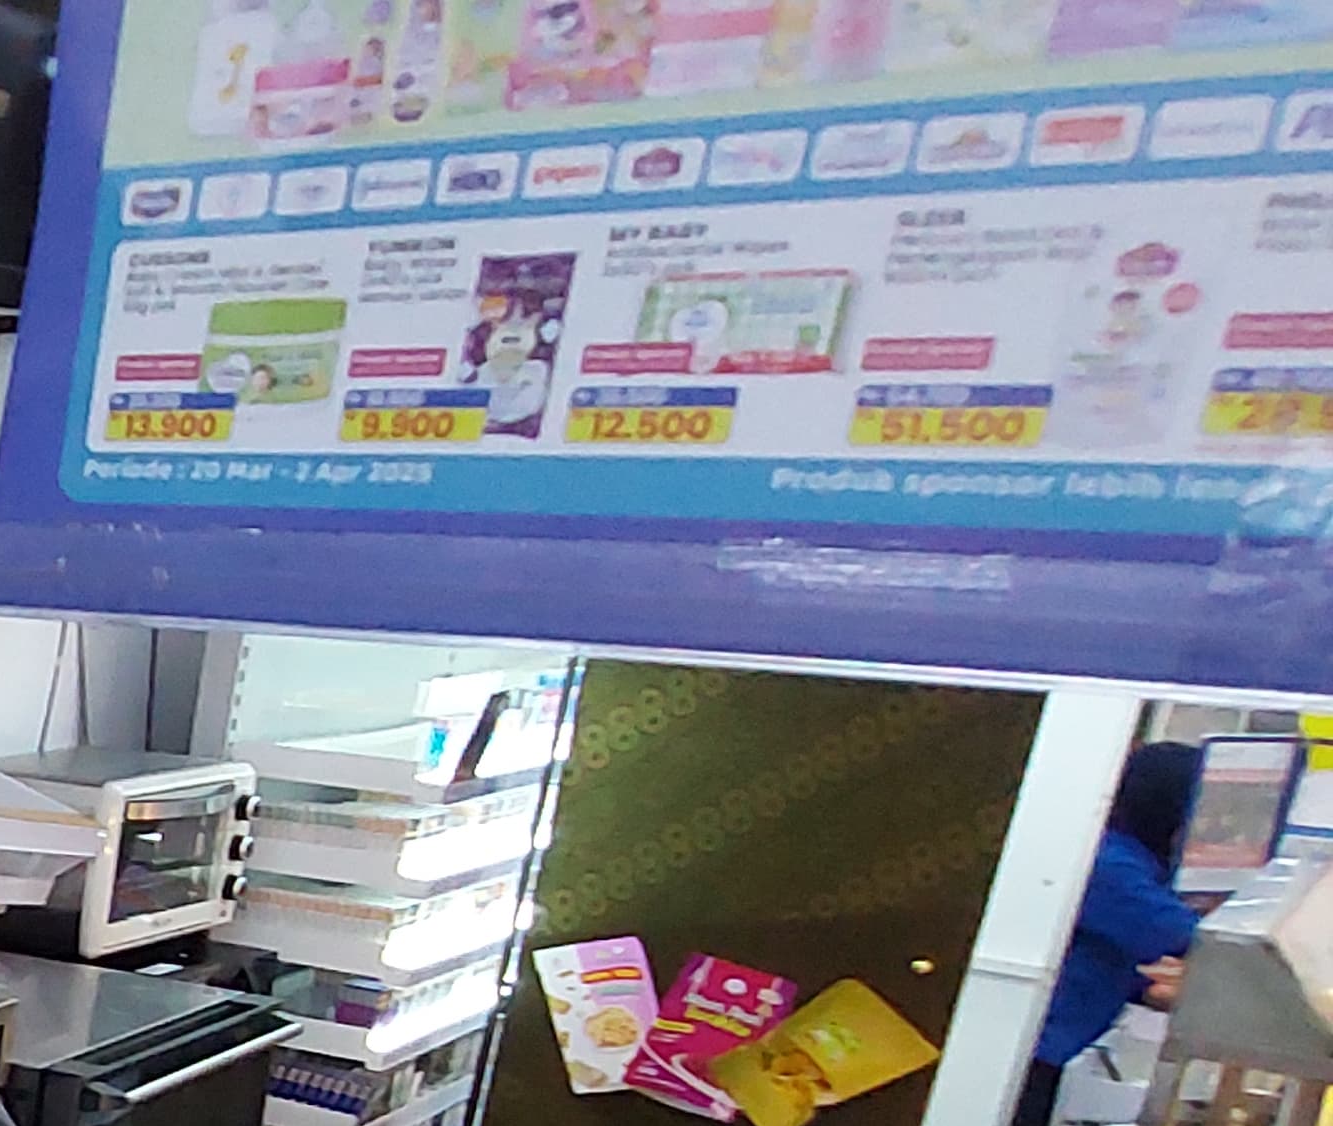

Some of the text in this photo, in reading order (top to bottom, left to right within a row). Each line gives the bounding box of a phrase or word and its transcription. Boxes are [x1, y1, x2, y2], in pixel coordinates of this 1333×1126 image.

[124, 412, 217, 439] 13.900
[361, 412, 454, 440] 9.900
[591, 410, 712, 440] 12.500
